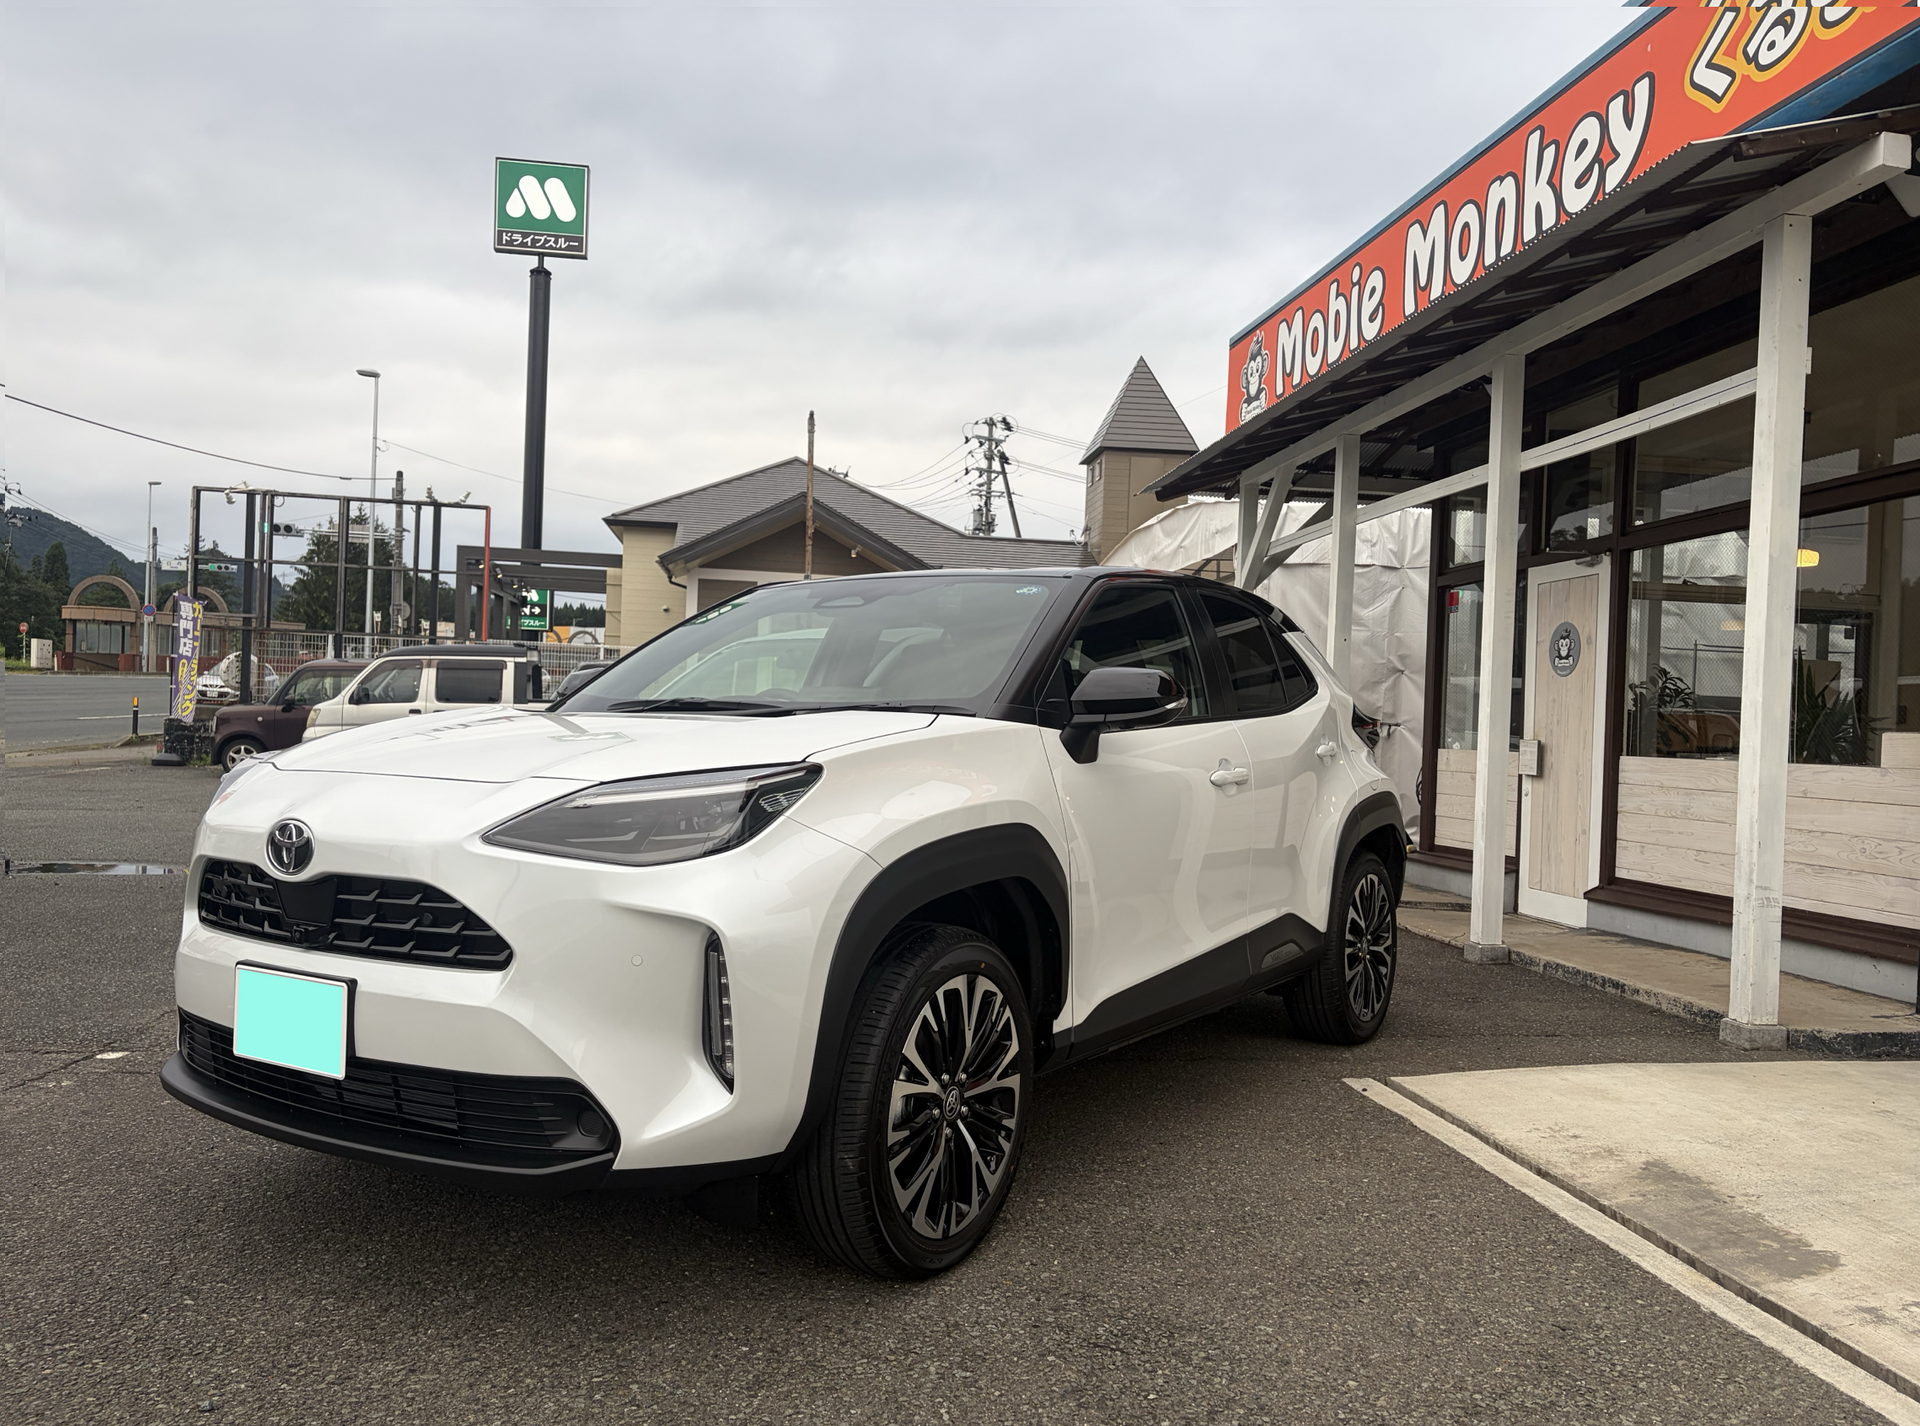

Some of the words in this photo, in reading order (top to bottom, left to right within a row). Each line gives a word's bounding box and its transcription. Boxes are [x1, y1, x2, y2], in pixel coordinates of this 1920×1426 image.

[502, 232, 579, 248] ドライブスルー
[1275, 262, 1386, 399] Mobie
[1403, 71, 1655, 319] Monkey
[179, 600, 194, 658] 専門店
